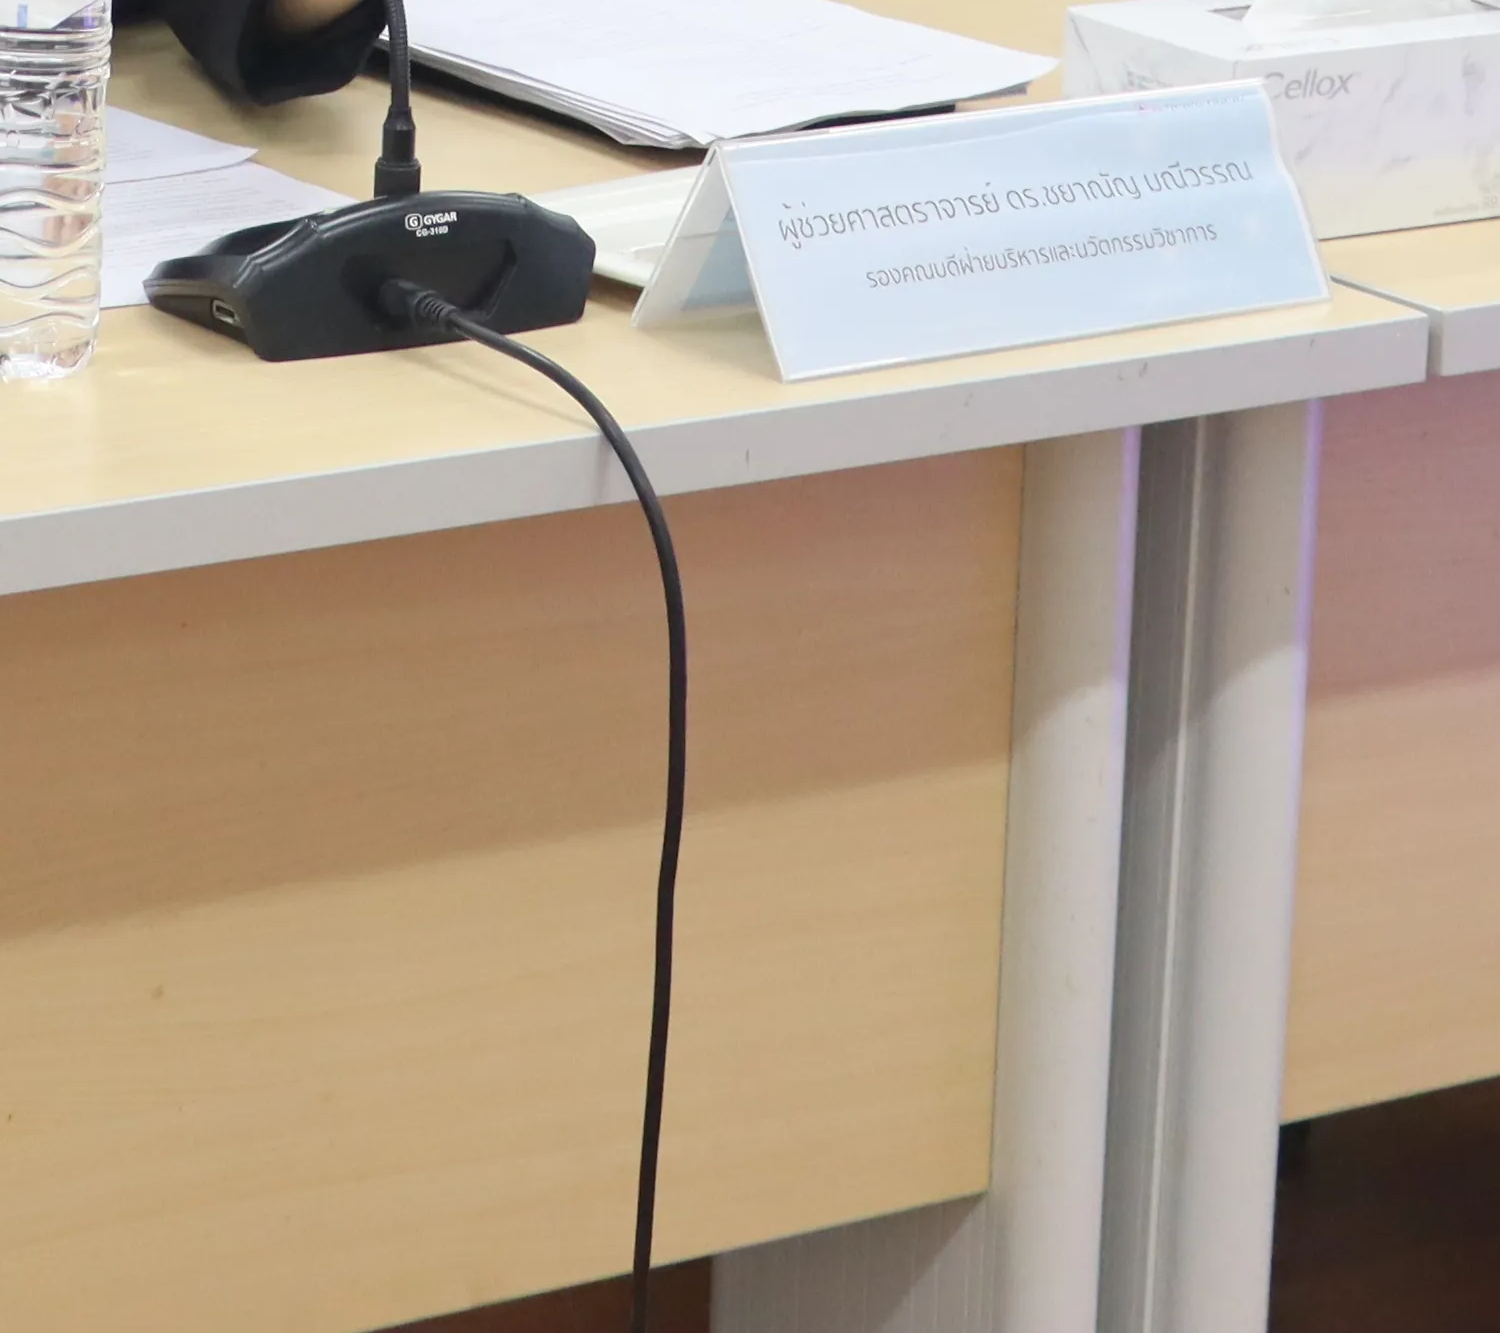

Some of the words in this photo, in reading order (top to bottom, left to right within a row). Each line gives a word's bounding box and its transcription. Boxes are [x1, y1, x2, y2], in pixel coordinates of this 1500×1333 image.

[423, 211, 458, 225] GYGAR
[777, 181, 1000, 250] ผู้ช่วยศาสตราจารย์
[865, 222, 1218, 289] รองคณบดีฝ่ายบริหารและนวัตกรรมวิชาการ
